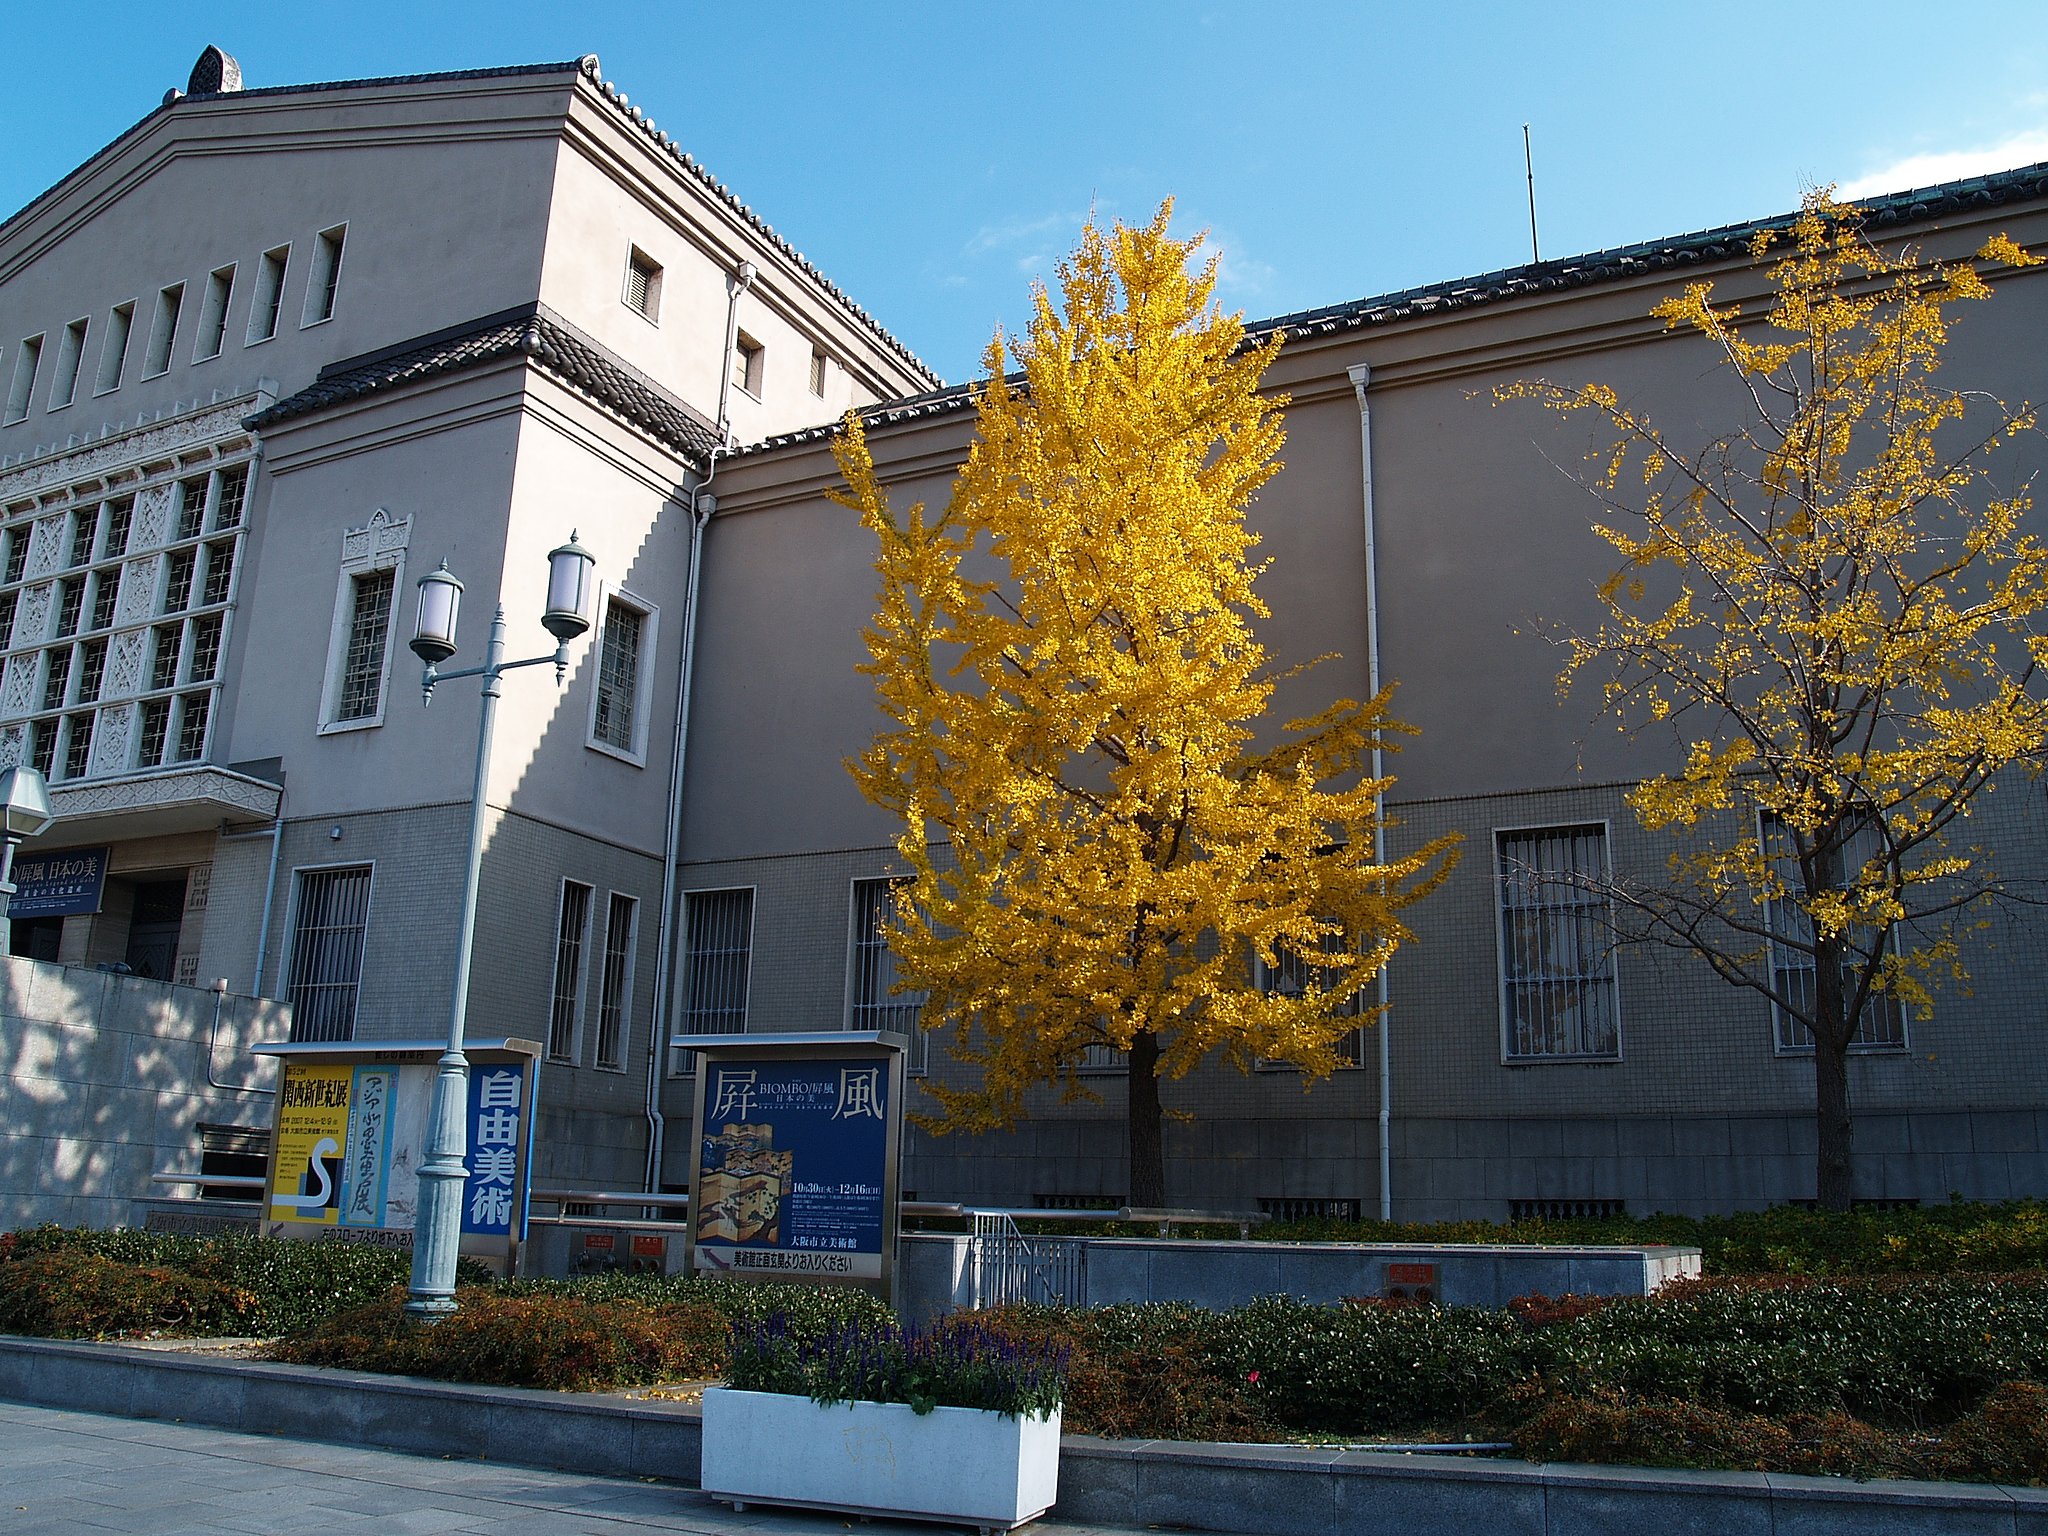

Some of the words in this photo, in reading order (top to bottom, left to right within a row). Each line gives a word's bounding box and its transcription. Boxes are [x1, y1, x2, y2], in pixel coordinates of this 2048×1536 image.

[49, 857, 97, 879] 日本の美
[282, 1079, 349, 1108] 関西新世紀展
[776, 1094, 816, 1103] 日本の美
[470, 1070, 523, 1226] 自由美術
[791, 1235, 857, 1249] 大阪市立美術館
[734, 1250, 852, 1272] 美術館正面玄関よりお入りください
